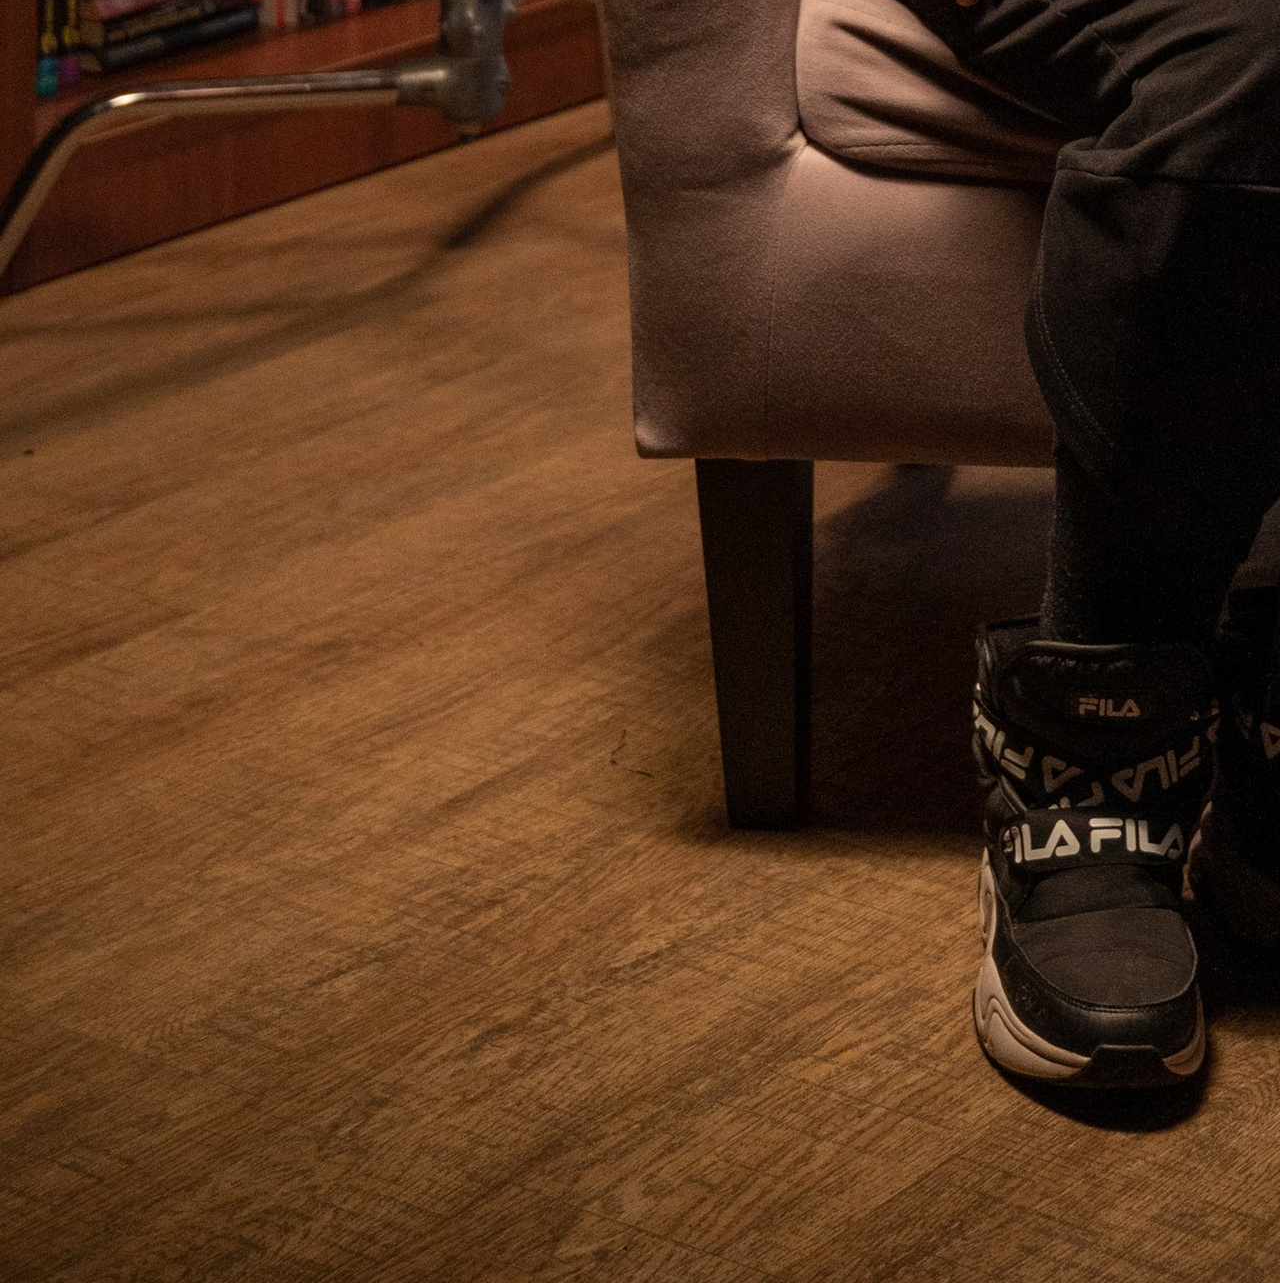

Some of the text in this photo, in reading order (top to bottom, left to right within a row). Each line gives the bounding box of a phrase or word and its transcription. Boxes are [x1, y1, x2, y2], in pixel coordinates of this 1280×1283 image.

[1078, 696, 1142, 718] FILA
[1110, 735, 1202, 804] FILA
[1088, 817, 1185, 860] FILA
